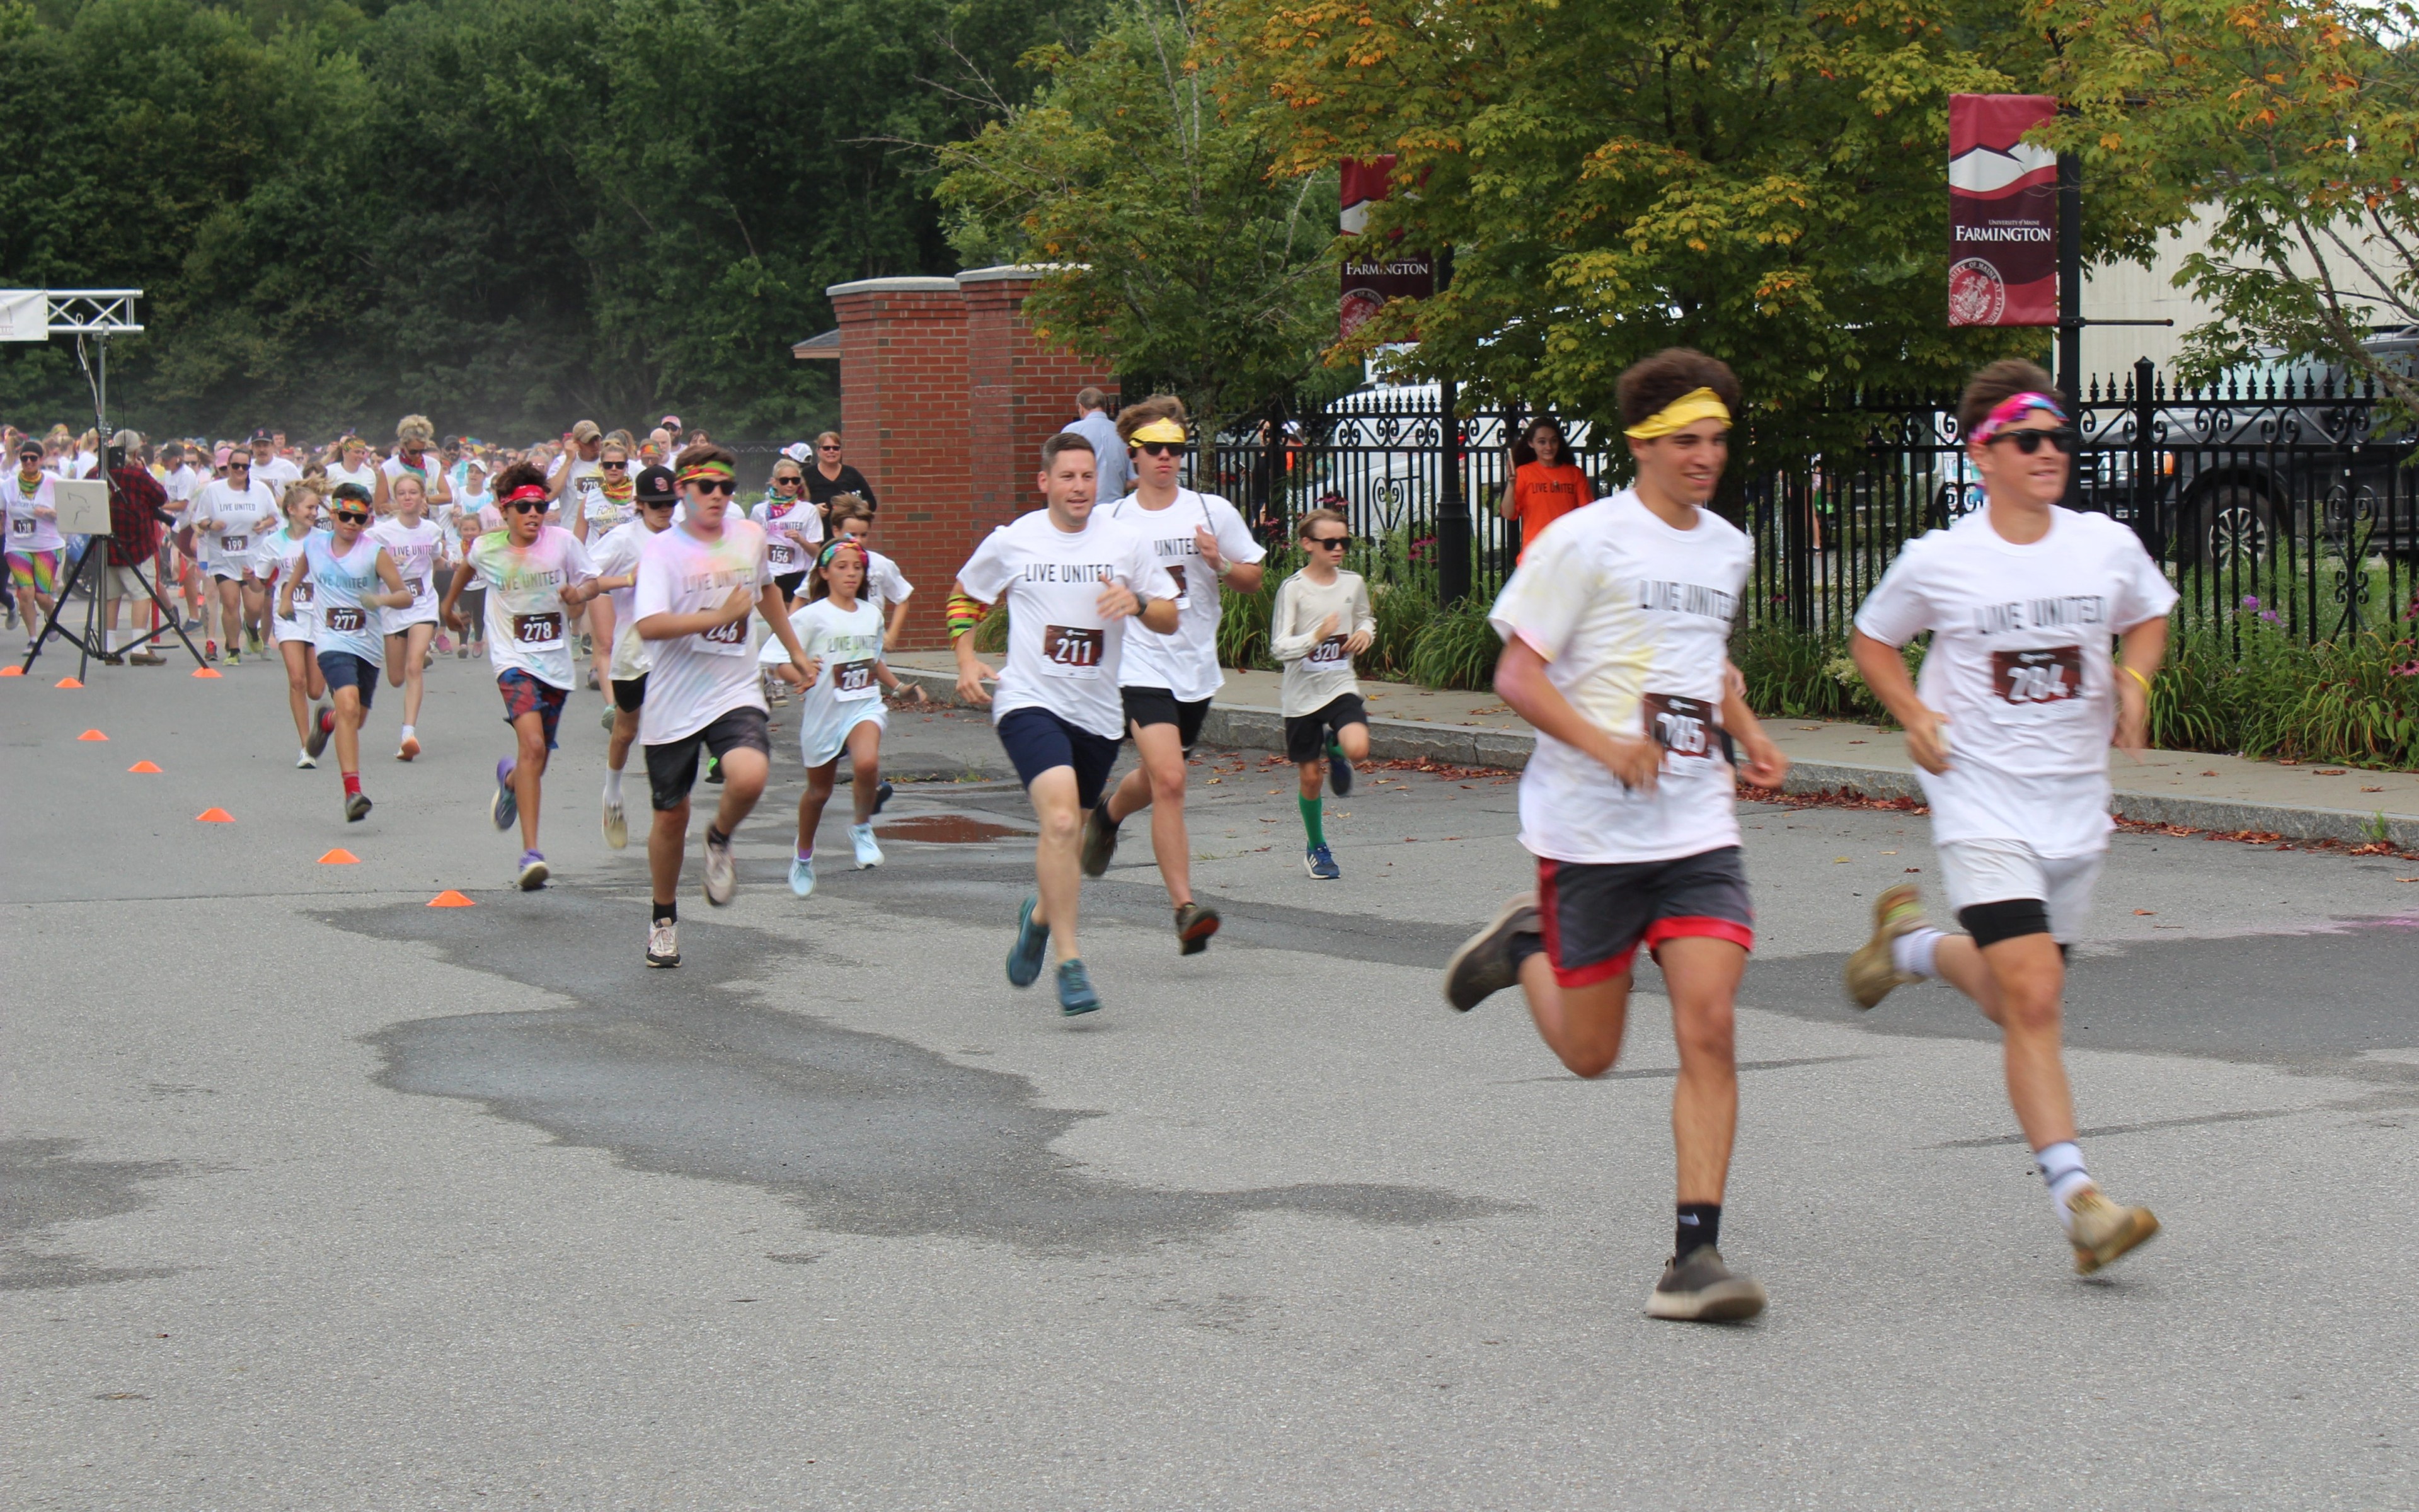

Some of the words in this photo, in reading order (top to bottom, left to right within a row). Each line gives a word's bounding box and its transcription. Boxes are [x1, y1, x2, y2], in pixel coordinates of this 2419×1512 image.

[1955, 226, 2051, 241] FARMINGTON
[1532, 483, 1548, 494] LIVE
[1550, 483, 1575, 494] UNITED
[219, 503, 233, 512] LIVE
[234, 503, 256, 512] UNITED
[18, 522, 32, 533] 138
[779, 521, 804, 531] UNITED
[227, 540, 243, 551] 199
[393, 546, 410, 557] LIVE
[411, 545, 434, 556] UNITE
[771, 549, 788, 563] 156
[522, 569, 561, 588] UNITED
[1025, 564, 1057, 582] LIVE
[1061, 564, 1114, 583] UNITED
[336, 576, 368, 589] UNITED
[292, 587, 306, 601] 06
[334, 615, 358, 630] 277
[523, 622, 553, 641] 278
[851, 634, 878, 651] UNITE
[1054, 638, 1092, 663] 211
[1313, 643, 1340, 661] 320
